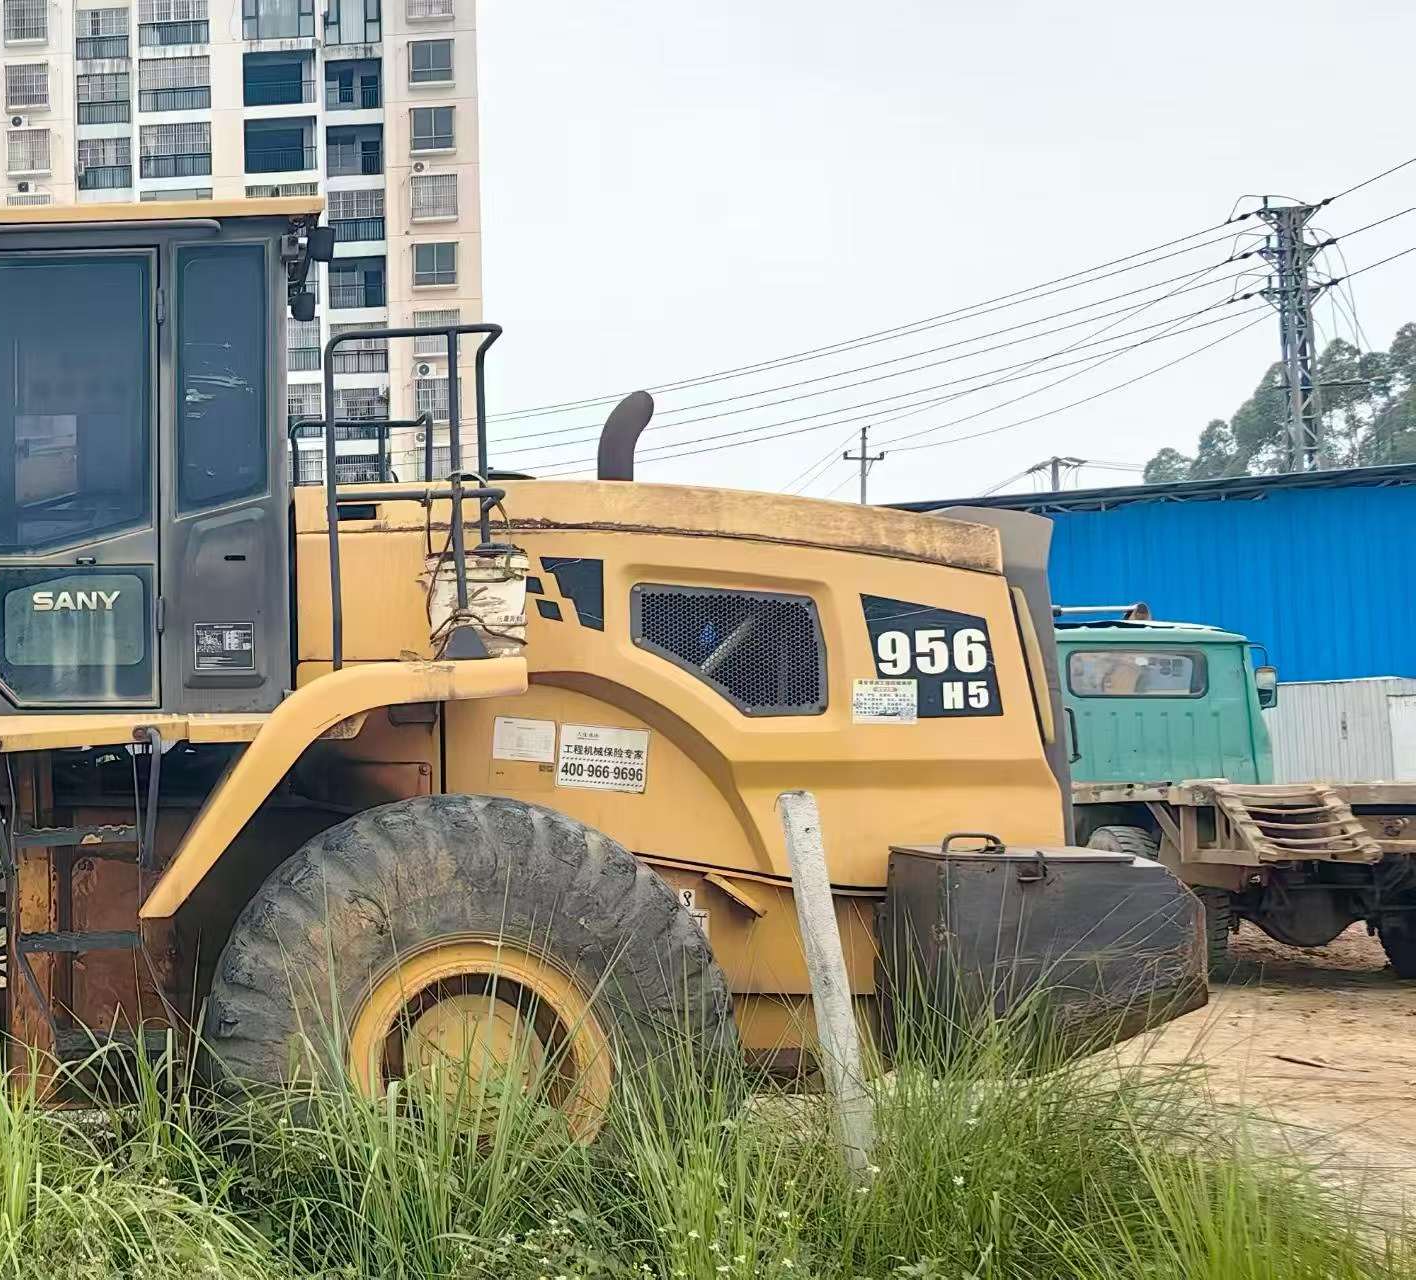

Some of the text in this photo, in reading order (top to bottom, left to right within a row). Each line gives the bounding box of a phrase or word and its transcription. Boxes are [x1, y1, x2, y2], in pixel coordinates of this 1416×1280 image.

[32, 590, 121, 611] SANY
[877, 628, 987, 676] 956
[942, 680, 990, 710] H5
[564, 744, 644, 760] 工程机械保险专家
[561, 762, 643, 782] 400-966-9696
